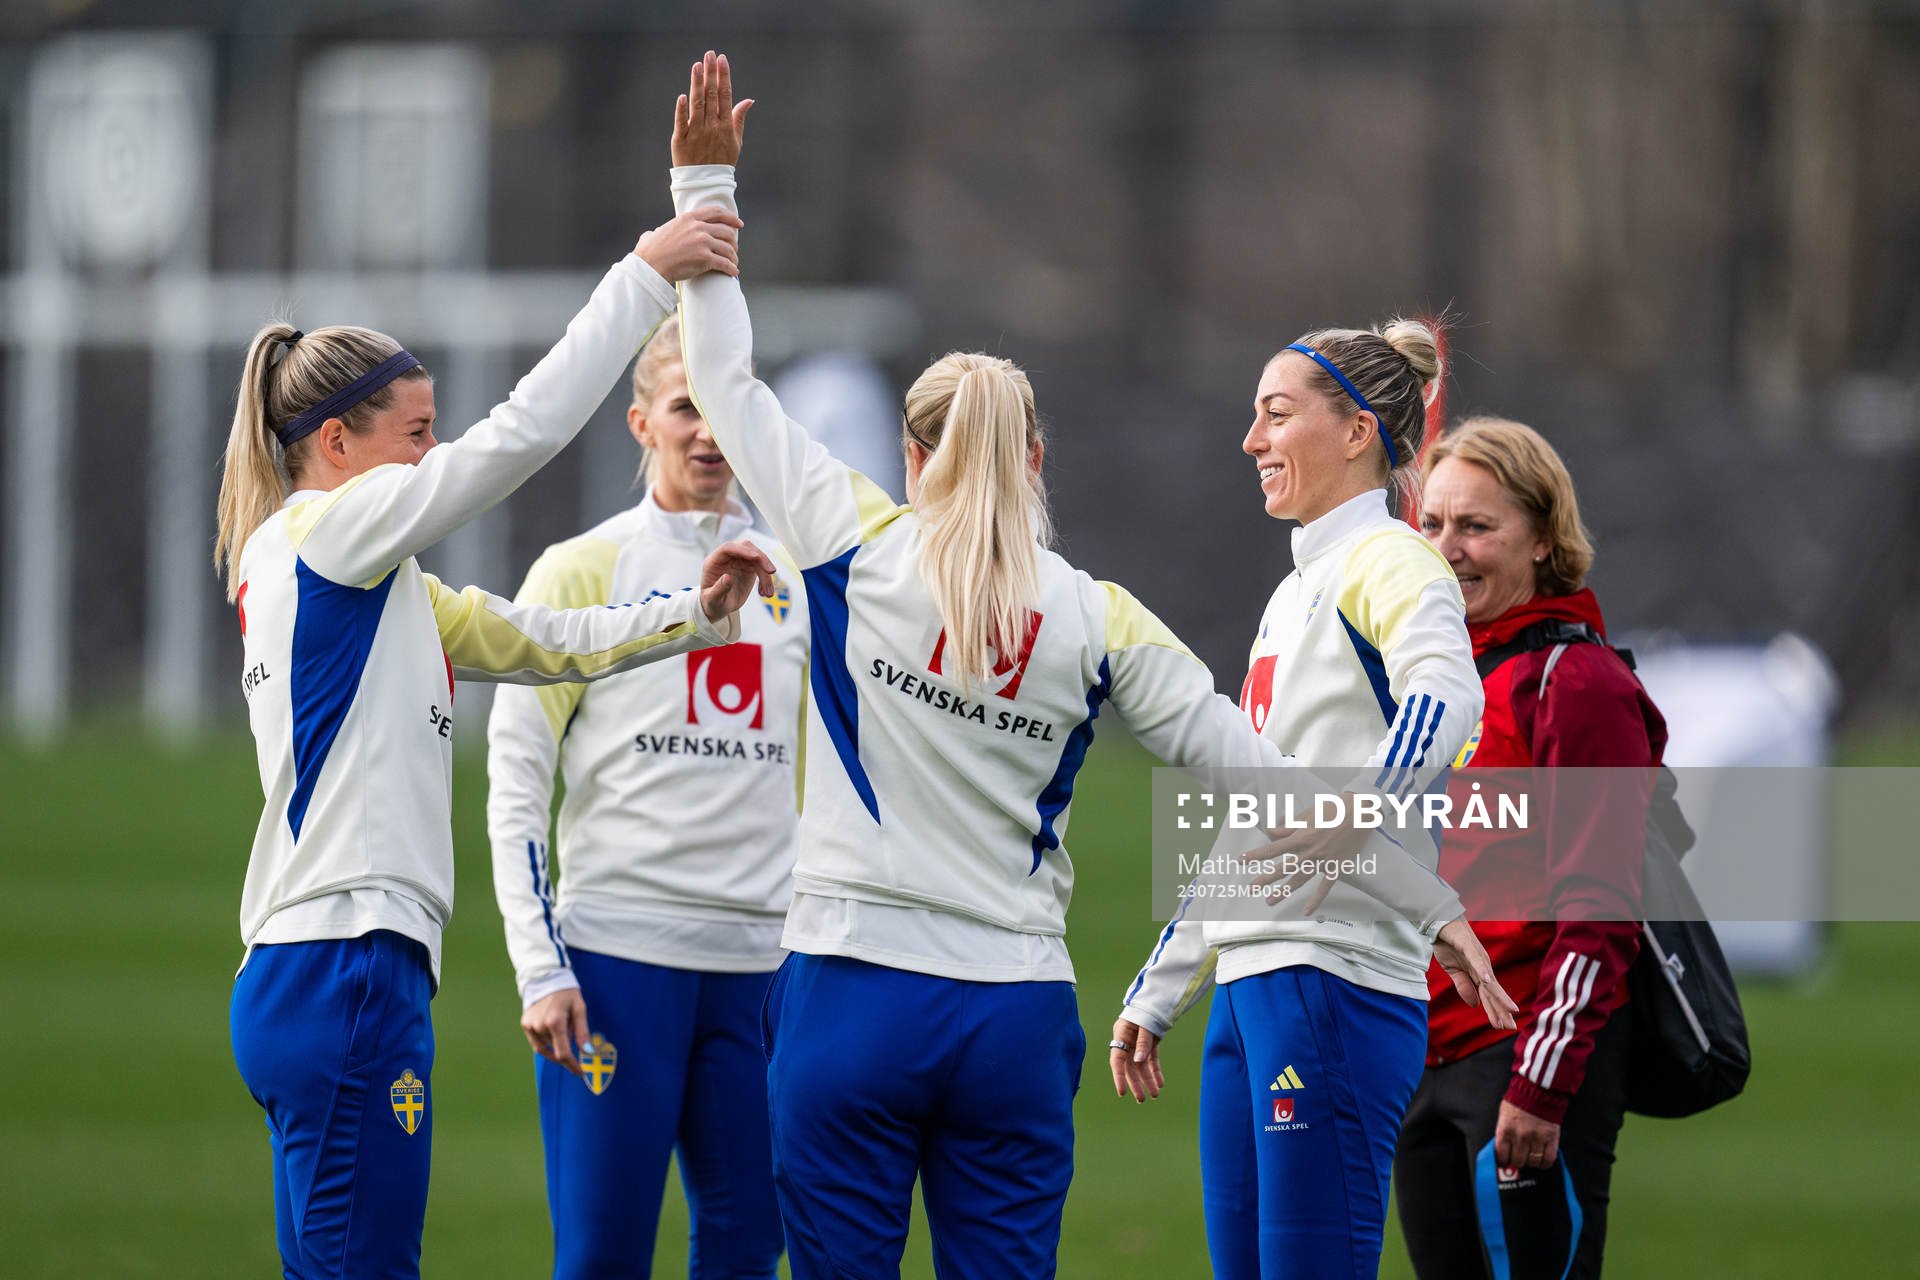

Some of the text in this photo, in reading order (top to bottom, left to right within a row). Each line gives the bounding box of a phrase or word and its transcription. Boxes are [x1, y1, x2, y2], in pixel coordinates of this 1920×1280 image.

[870, 658, 1054, 742] SVENSKA SPEL
[635, 734, 747, 759] SVENSKA
[1264, 1122, 1309, 1132] SVENSKA SPEL
